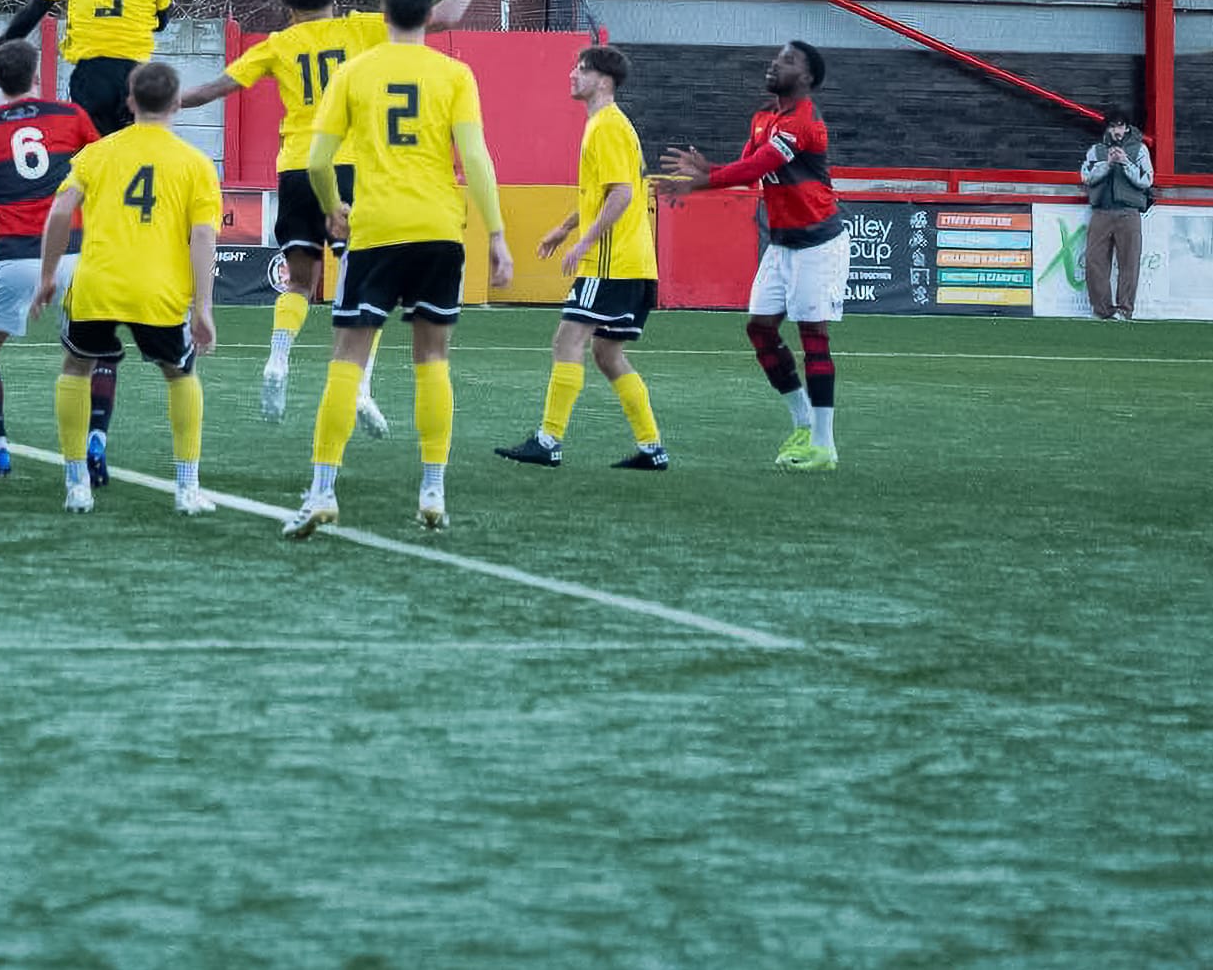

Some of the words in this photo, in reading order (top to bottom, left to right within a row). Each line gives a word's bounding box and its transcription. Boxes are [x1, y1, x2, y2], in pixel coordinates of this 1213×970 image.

[297, 49, 347, 106] 10
[387, 83, 419, 146] 2
[10, 126, 50, 180] 6
[123, 164, 157, 224] 4
[849, 243, 892, 264] oup
